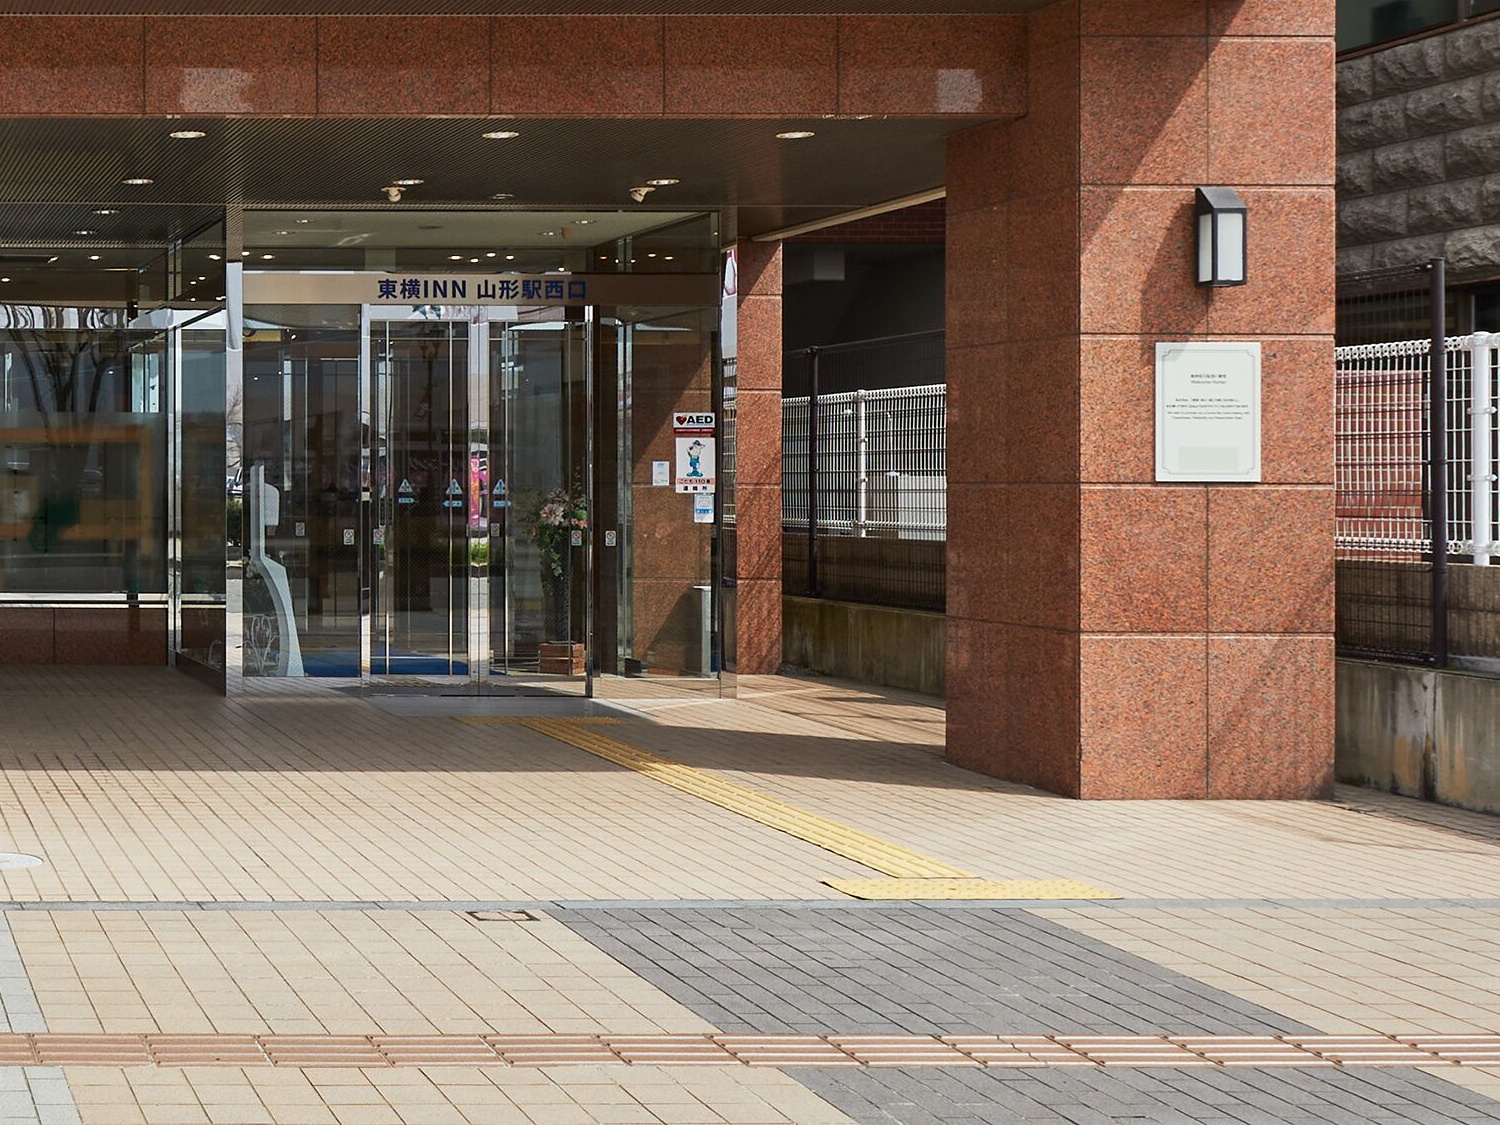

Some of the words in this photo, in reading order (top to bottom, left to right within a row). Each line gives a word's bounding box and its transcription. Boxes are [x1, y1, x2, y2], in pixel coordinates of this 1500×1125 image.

[377, 278, 467, 300] 東横INN
[476, 278, 587, 300] 山形駅西口
[686, 415, 714, 424] AED
